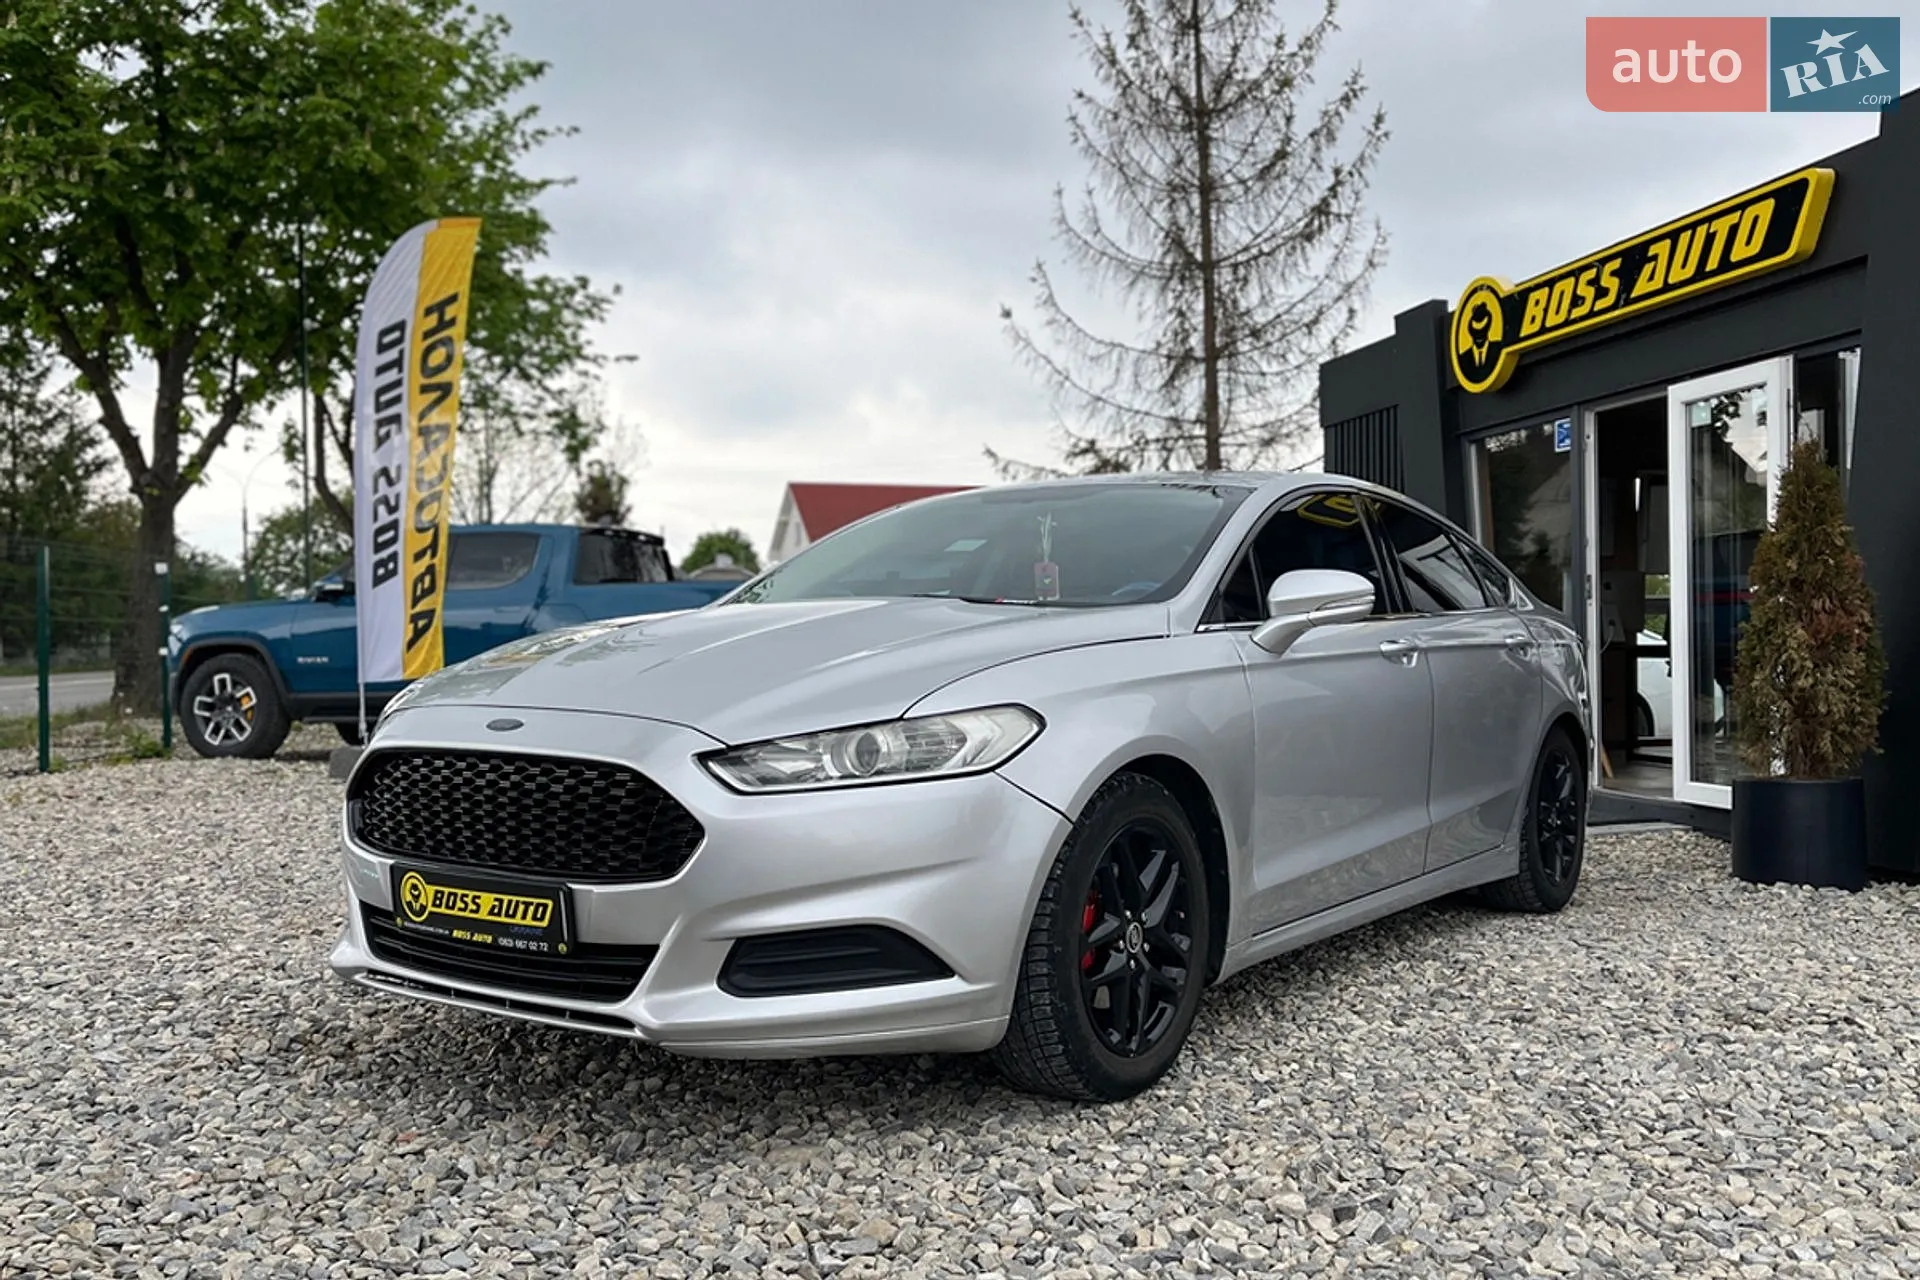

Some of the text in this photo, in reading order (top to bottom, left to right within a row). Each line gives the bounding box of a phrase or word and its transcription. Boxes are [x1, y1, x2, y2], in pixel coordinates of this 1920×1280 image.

[1519, 198, 1776, 338] BOSS AUTO
[431, 889, 548, 921] BOSS AUTO
